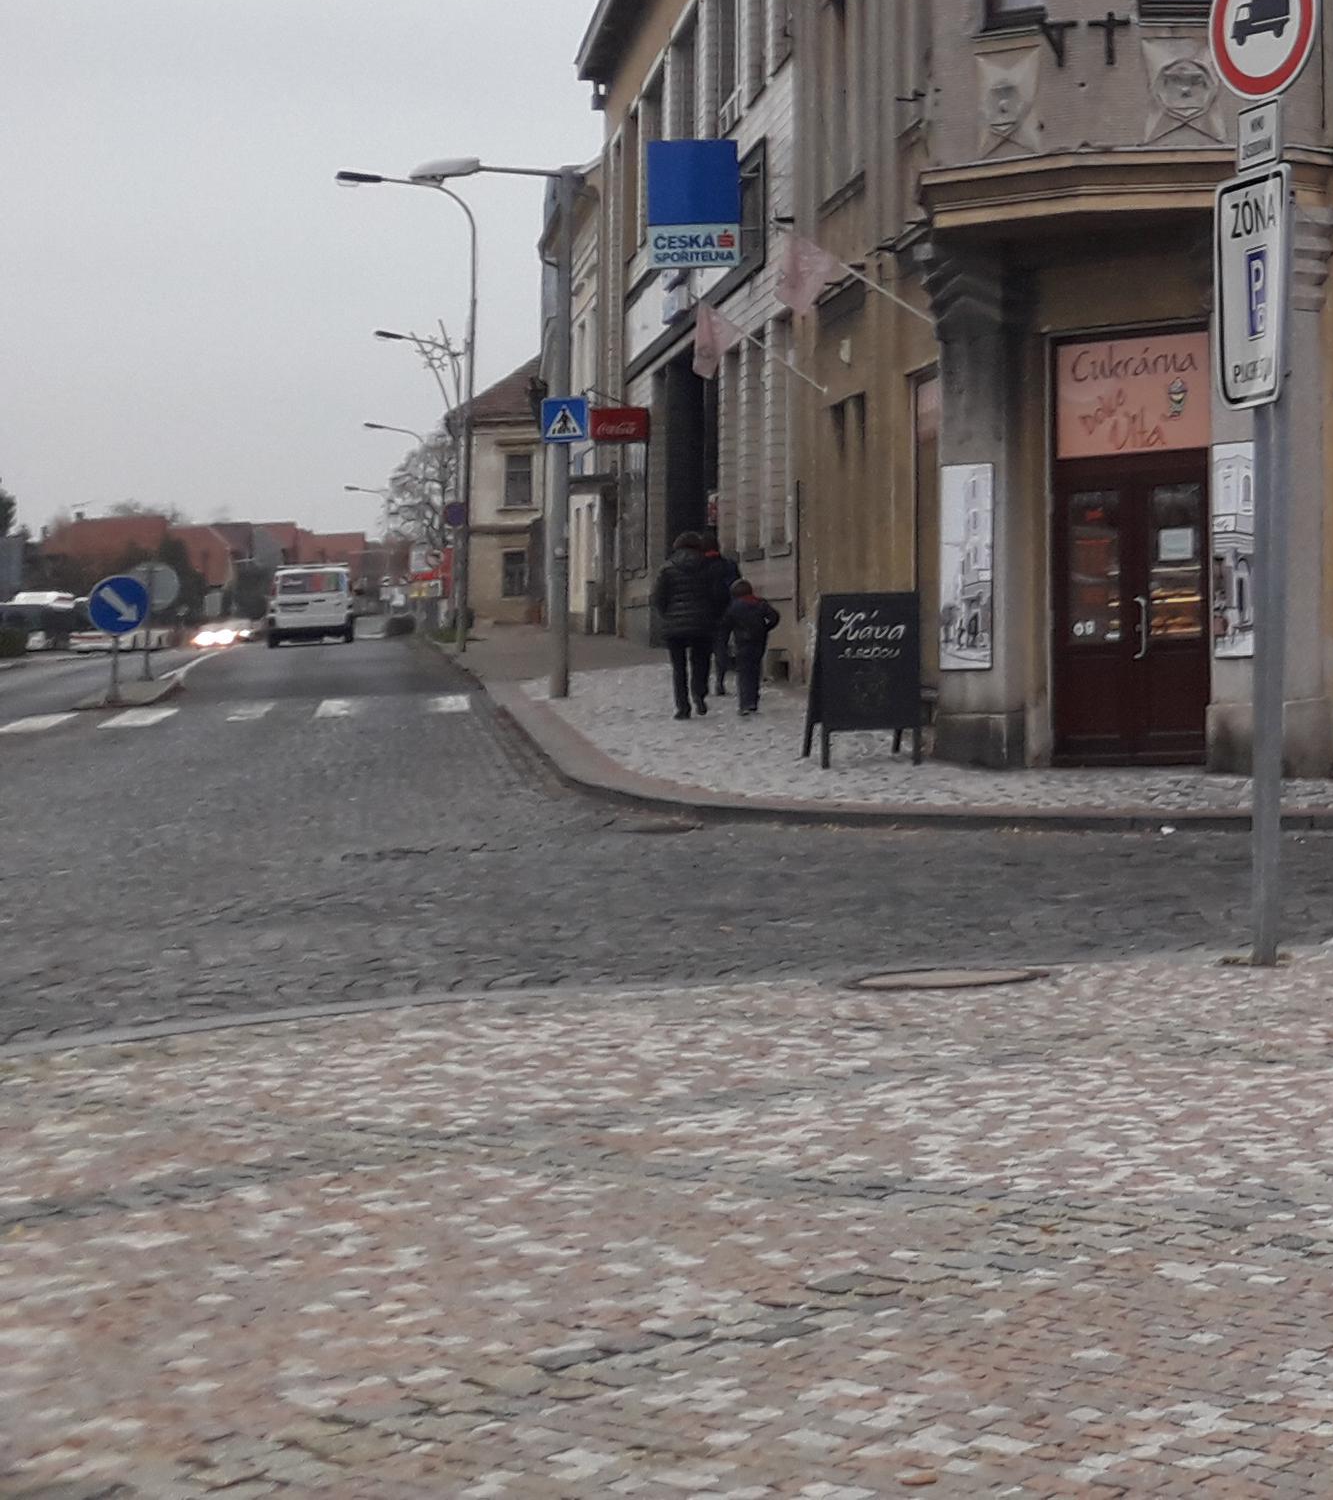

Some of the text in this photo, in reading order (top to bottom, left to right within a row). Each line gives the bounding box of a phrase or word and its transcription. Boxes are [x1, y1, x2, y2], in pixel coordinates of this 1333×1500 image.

[1230, 192, 1276, 239] ZÓNA
[654, 233, 715, 250] ČESKÁ
[654, 250, 735, 263] SPOŘITELNA
[1071, 344, 1198, 382] Cukrárna
[830, 608, 906, 641] Káva
